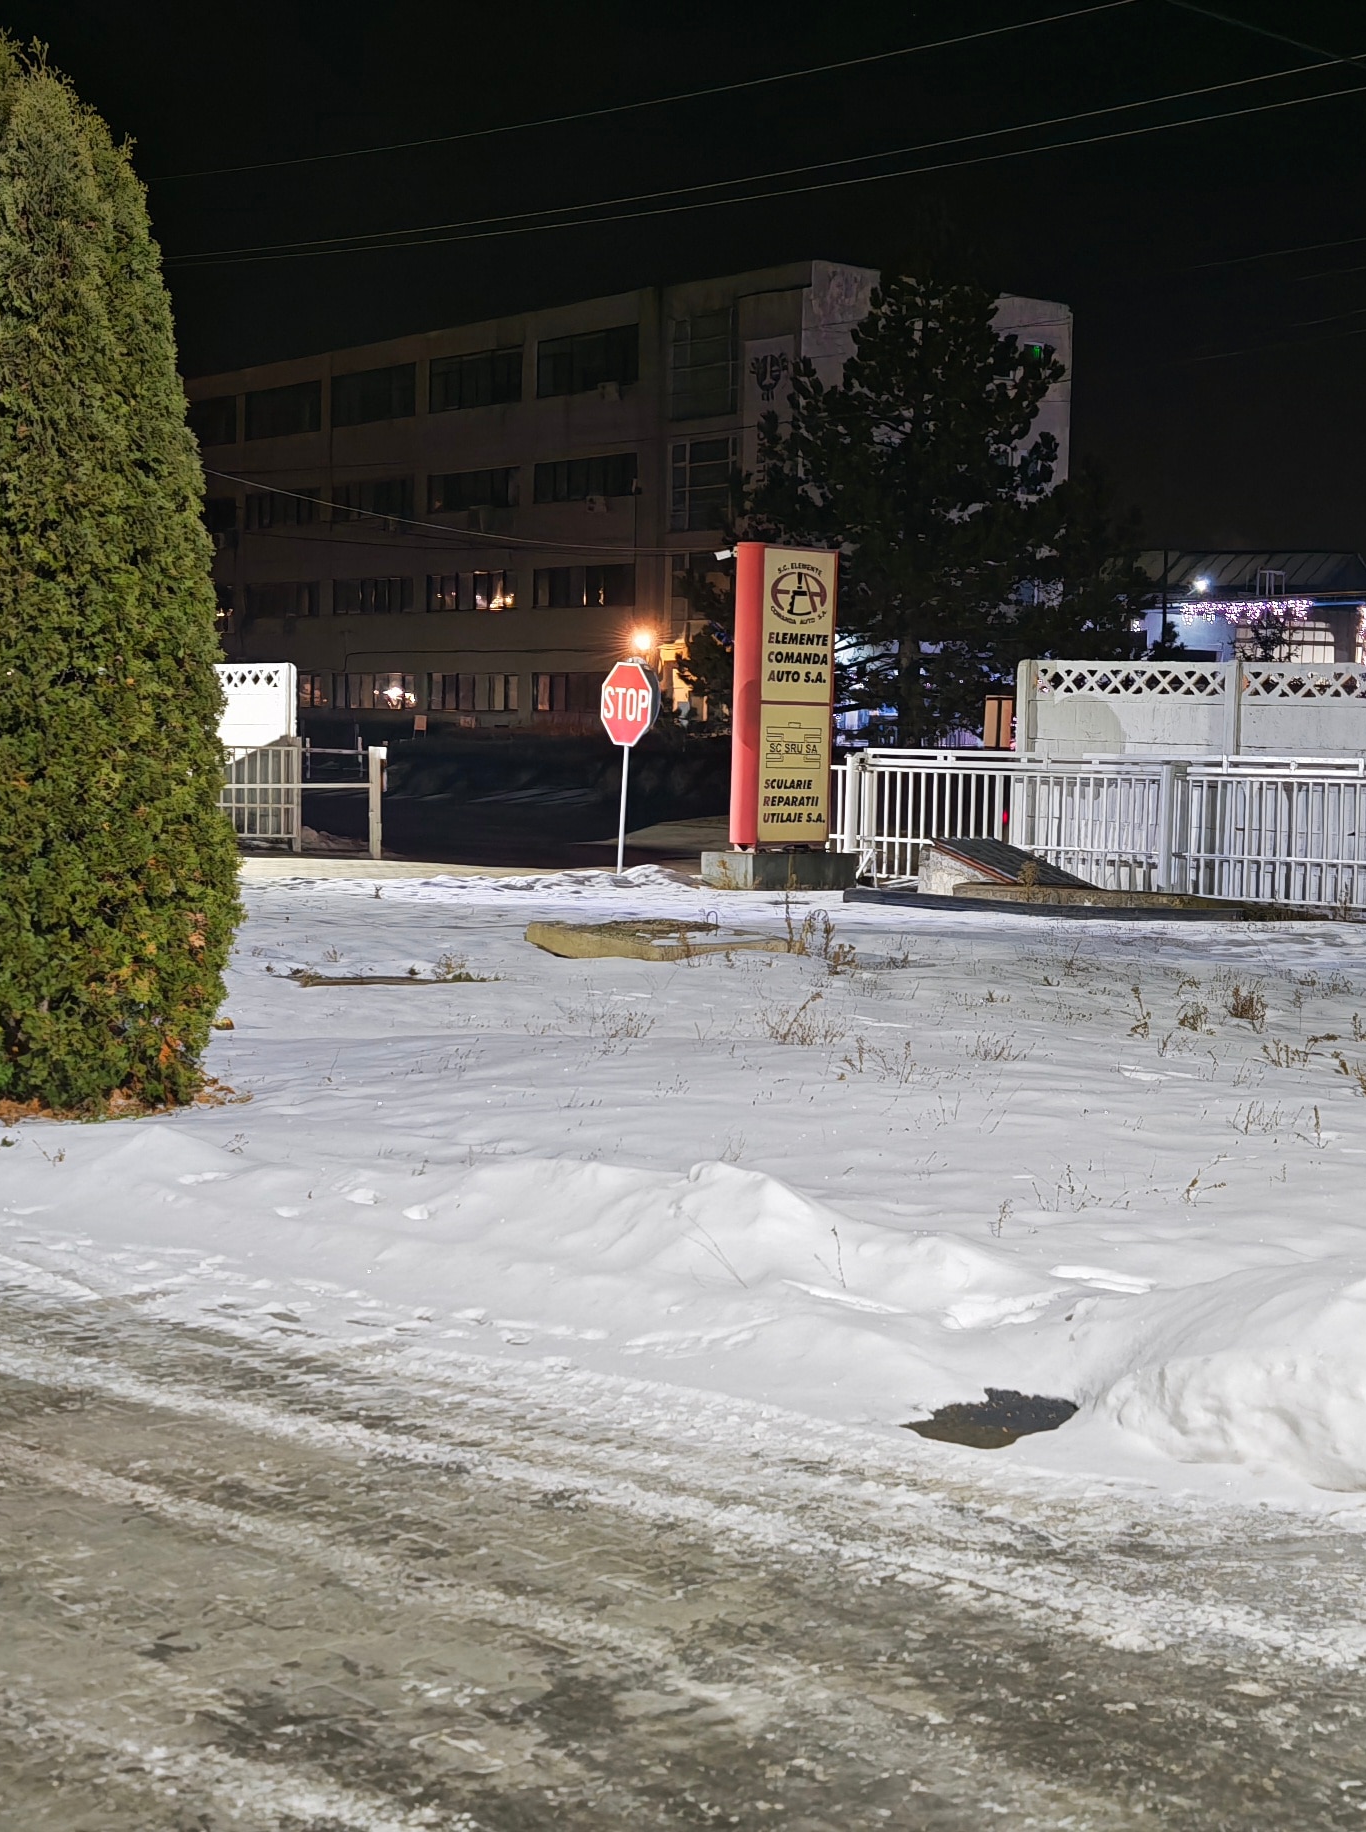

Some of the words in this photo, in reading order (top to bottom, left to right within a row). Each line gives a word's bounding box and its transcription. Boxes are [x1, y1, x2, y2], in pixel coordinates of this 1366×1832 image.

[767, 632, 829, 646] ELEMENTE
[767, 651, 828, 665] COMANDA
[767, 670, 800, 683] AUTO
[804, 671, 826, 684] S.A.
[603, 685, 649, 722] STOP
[769, 742, 782, 753] SC
[784, 743, 803, 754] SRU
[805, 743, 818, 754] SA
[763, 778, 813, 790] SCULARIE
[762, 795, 819, 807] REPARATII
[762, 812, 804, 824] UTILAJE
[805, 812, 826, 824] S.A.
